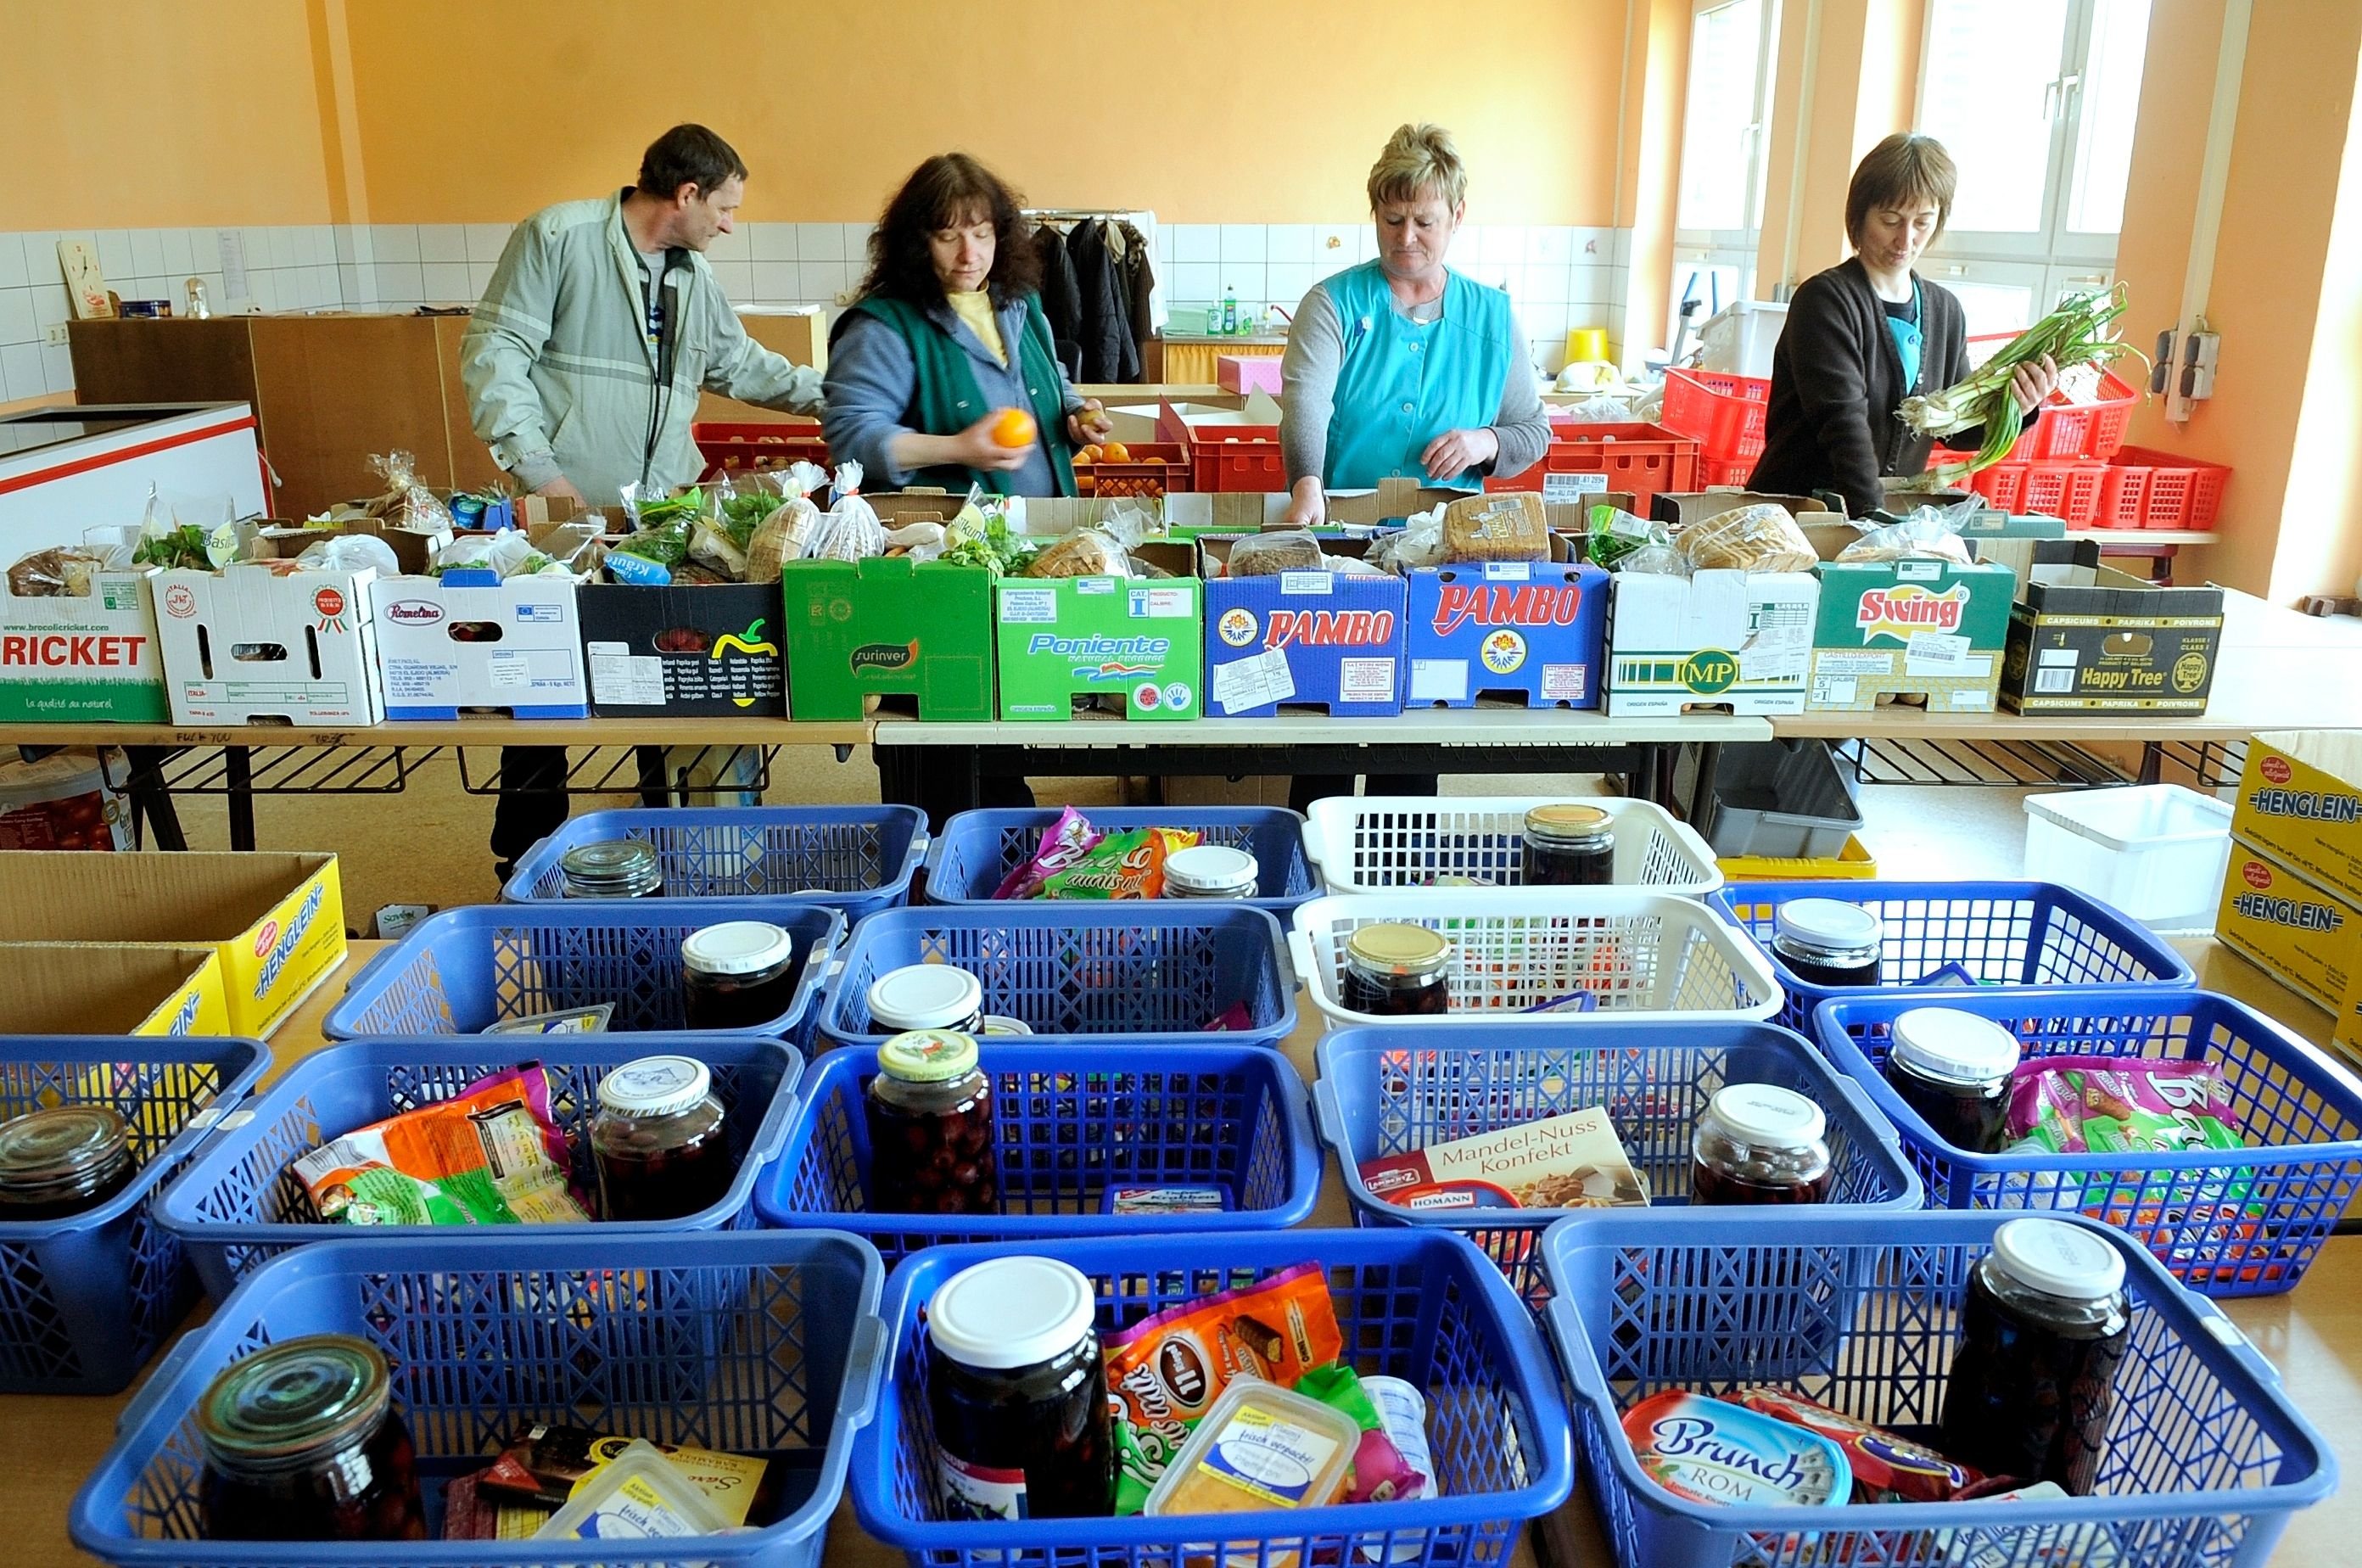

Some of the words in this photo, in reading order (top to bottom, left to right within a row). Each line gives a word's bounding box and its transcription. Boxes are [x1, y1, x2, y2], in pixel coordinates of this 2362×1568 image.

[390, 603, 440, 619] Romelina
[1431, 585, 1582, 637] PAMBO
[1860, 592, 1960, 628] Swing
[2046, 617, 2100, 625] CAPSICUMS
[3, 624, 109, 632] www.brocolicricket.com
[1262, 610, 1394, 652] PAMBO
[3, 636, 147, 666] RICKET
[854, 652, 907, 662] surinver
[1028, 633, 1170, 654] Poniente
[1688, 663, 1734, 684] MP
[2080, 667, 2129, 689] Happy
[2131, 668, 2163, 686] Tree
[2180, 662, 2201, 672] Happy
[2032, 699, 2085, 708] CAPSICUMS
[2254, 787, 2358, 823] HENGLEIN
[2238, 892, 2336, 932] HENGLEIN
[259, 888, 323, 999] HENGLEIN
[1442, 1119, 1598, 1166] Mandel-Nuss
[1480, 1141, 1573, 1174] Konfekt
[1413, 1194, 1471, 1207] HOMANN
[1174, 1369, 1201, 1396] 11
[1240, 1430, 1268, 1444] frisch
[1653, 1417, 1805, 1491] Brunch
[1691, 1467, 1755, 1503] ROM
